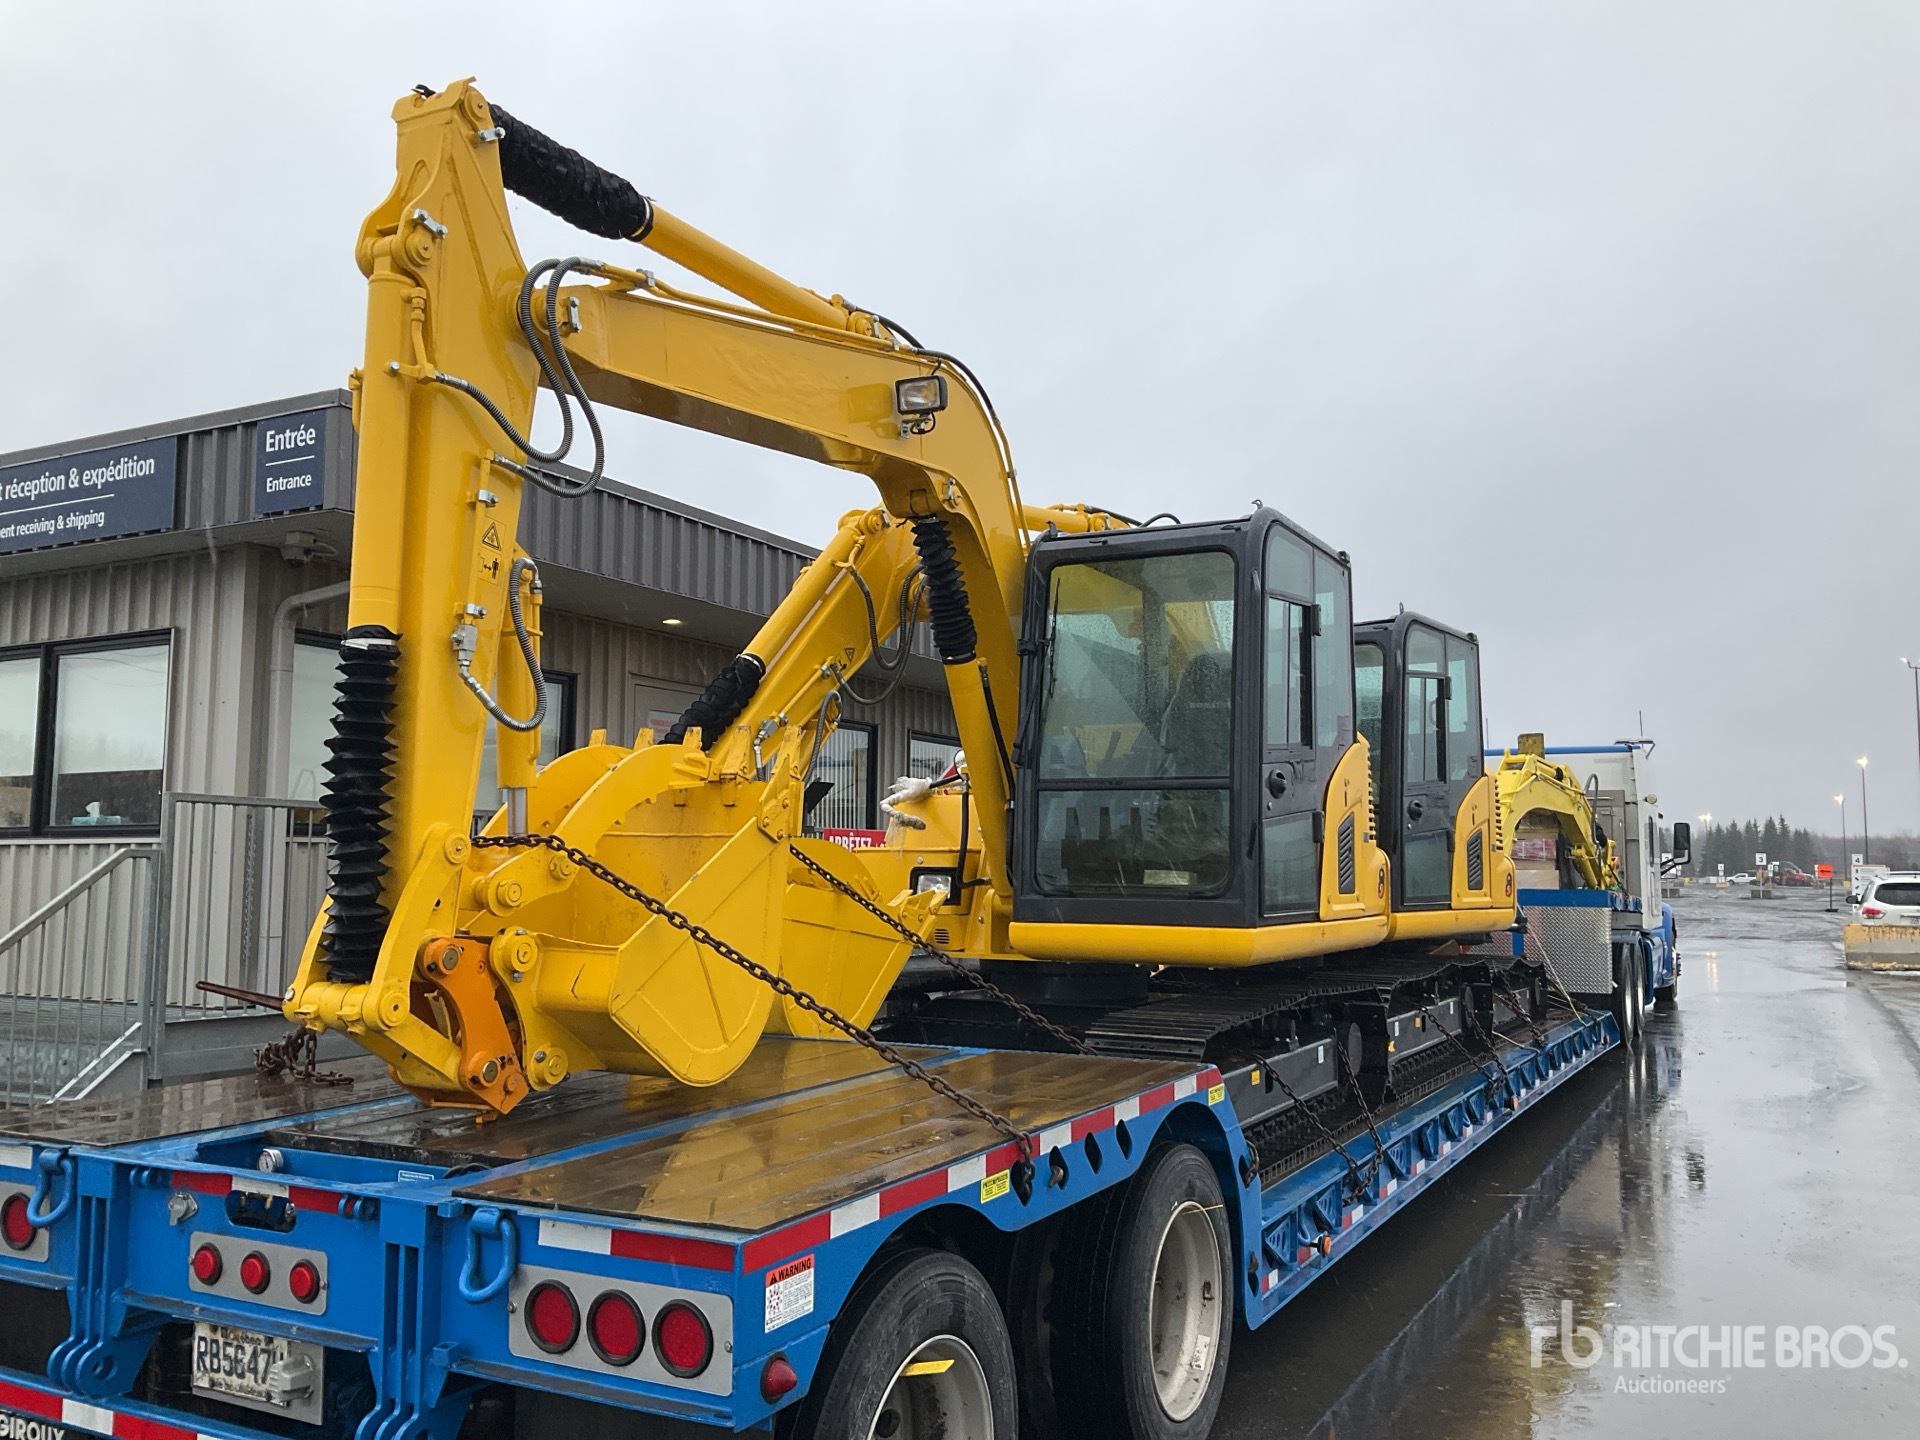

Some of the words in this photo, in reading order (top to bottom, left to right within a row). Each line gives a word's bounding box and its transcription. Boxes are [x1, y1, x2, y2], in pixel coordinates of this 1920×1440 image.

[265, 424, 316, 452] Entrée
[5, 471, 65, 501] réception
[68, 467, 79, 488] &
[82, 455, 155, 489] expédition
[266, 474, 312, 493] Entrance
[0, 525, 15, 539] ent
[16, 517, 55, 535] receiving
[56, 514, 65, 529] &
[65, 509, 105, 531] shipping
[778, 1257, 812, 1281] WARNING
[196, 1334, 284, 1385] RB5647
